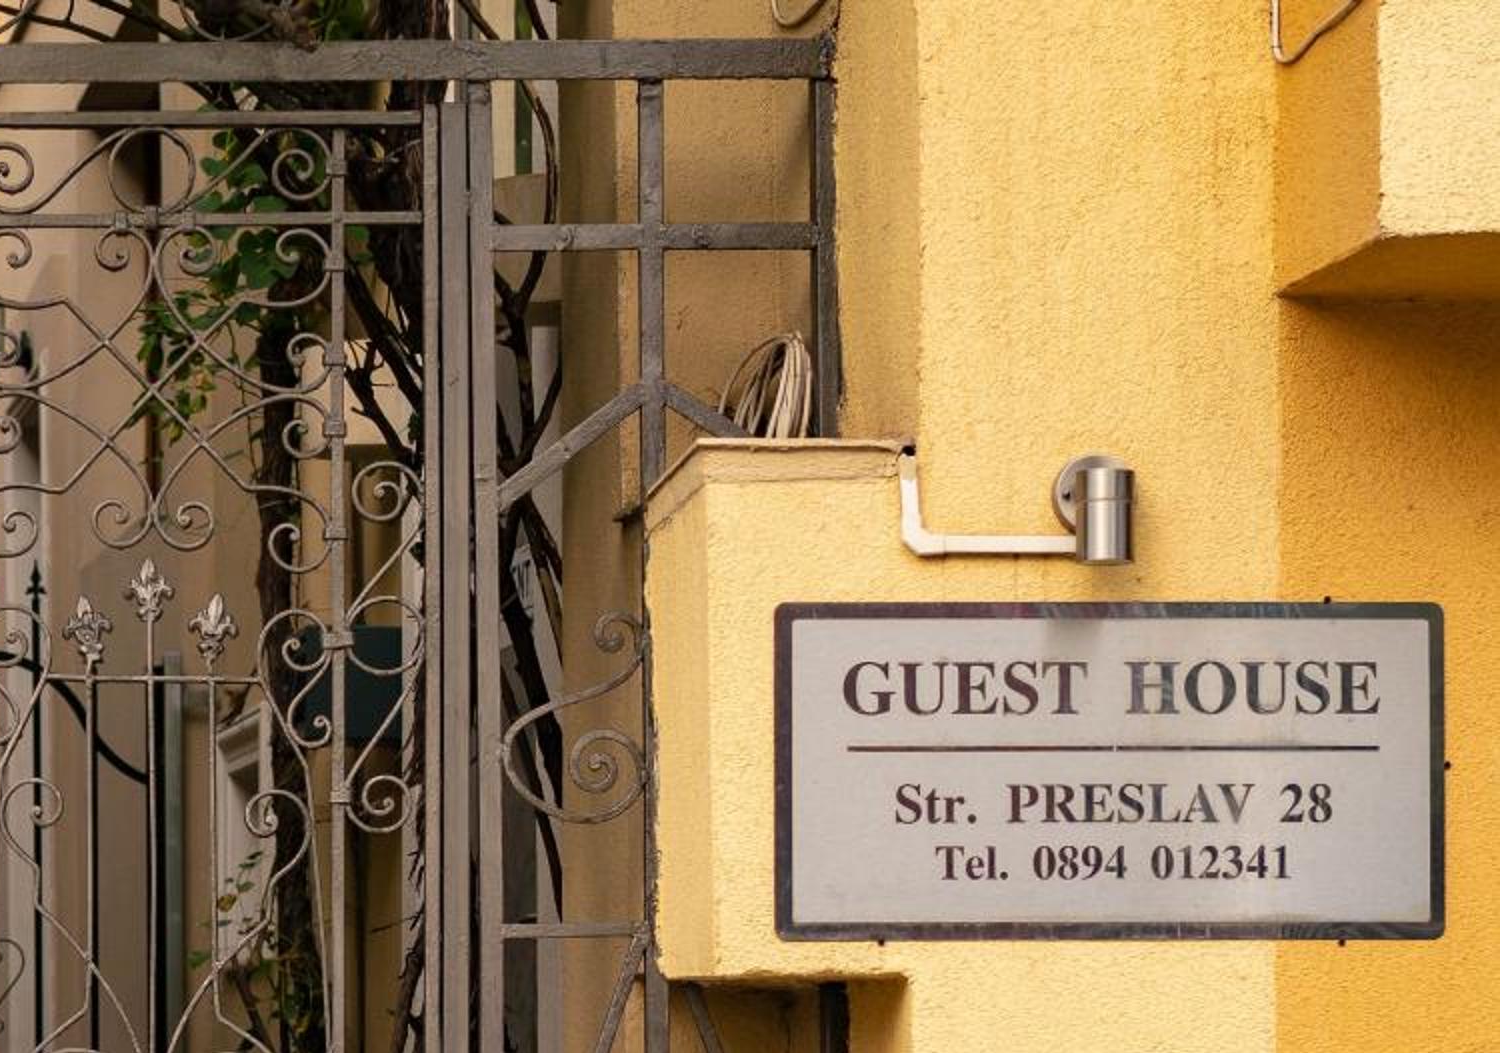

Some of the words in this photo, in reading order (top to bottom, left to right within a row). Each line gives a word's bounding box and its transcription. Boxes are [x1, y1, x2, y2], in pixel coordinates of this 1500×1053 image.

[843, 660, 1088, 716] GUEST
[1123, 660, 1381, 716] HOUSE
[895, 783, 977, 825] Str.
[1007, 783, 1255, 825] PRESLAV
[1280, 783, 1333, 825] 28
[935, 845, 1009, 882] Tel.
[1032, 845, 1128, 882] 0894
[1150, 844, 1291, 882] 012341
